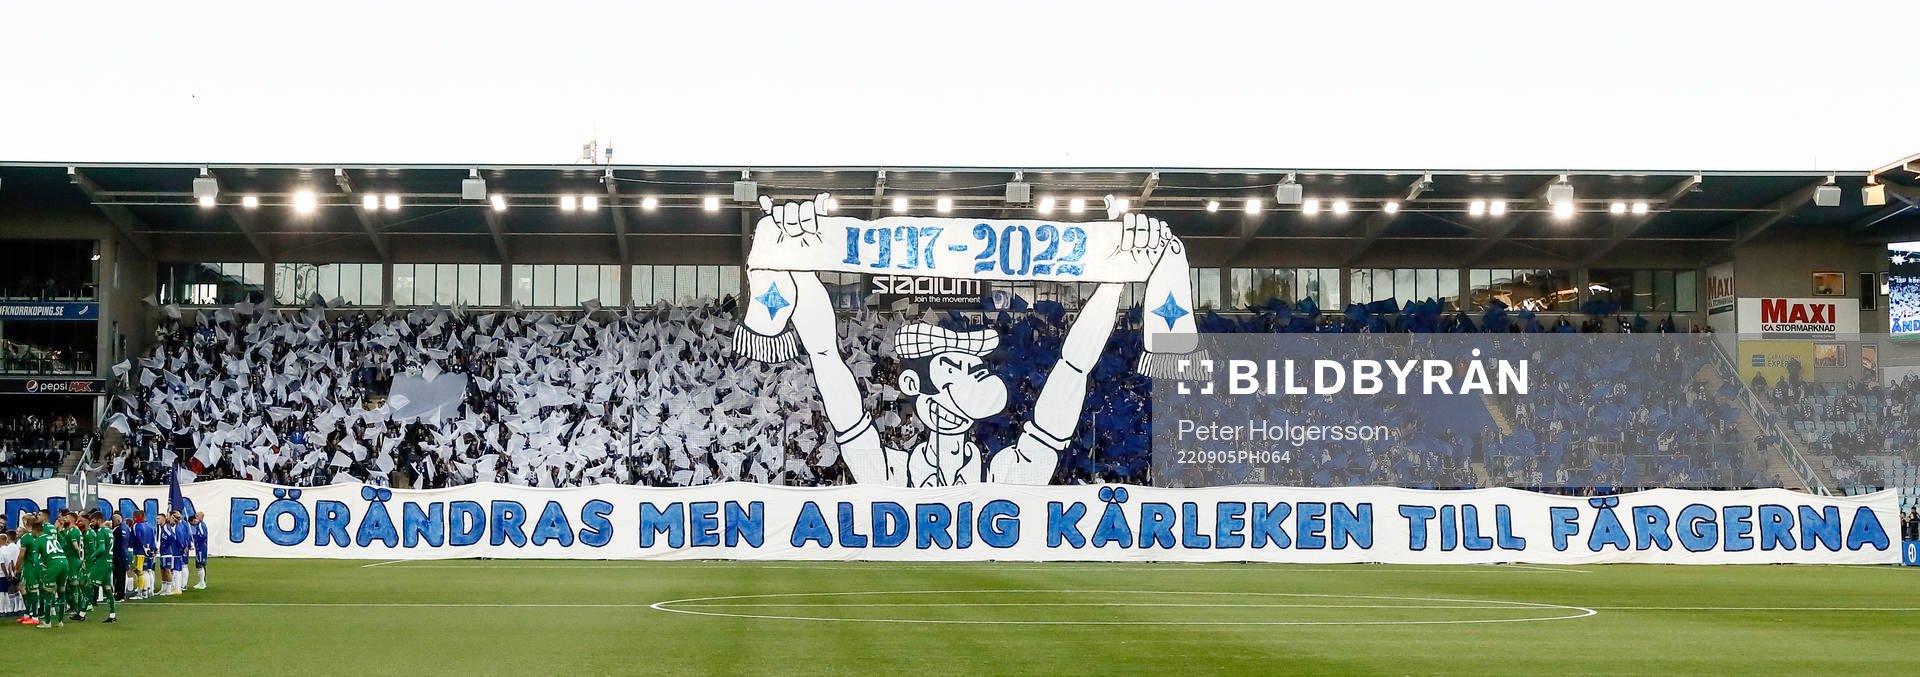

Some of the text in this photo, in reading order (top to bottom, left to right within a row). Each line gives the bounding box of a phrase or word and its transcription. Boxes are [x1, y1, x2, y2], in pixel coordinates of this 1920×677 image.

[1707, 276, 1733, 299] MAXI
[1761, 298, 1836, 324] MAXI
[1761, 324, 1836, 332] ICA STORMARKNAD
[40, 382, 68, 392] pepsi
[229, 486, 613, 548] FÖRÄNDRAS
[639, 501, 765, 549] MEN
[790, 499, 1020, 549] ALDRIG
[1046, 486, 1373, 550] KÄRLEKEN
[1399, 504, 1526, 551] TILL
[1549, 496, 1890, 552] FÄRGERNA
